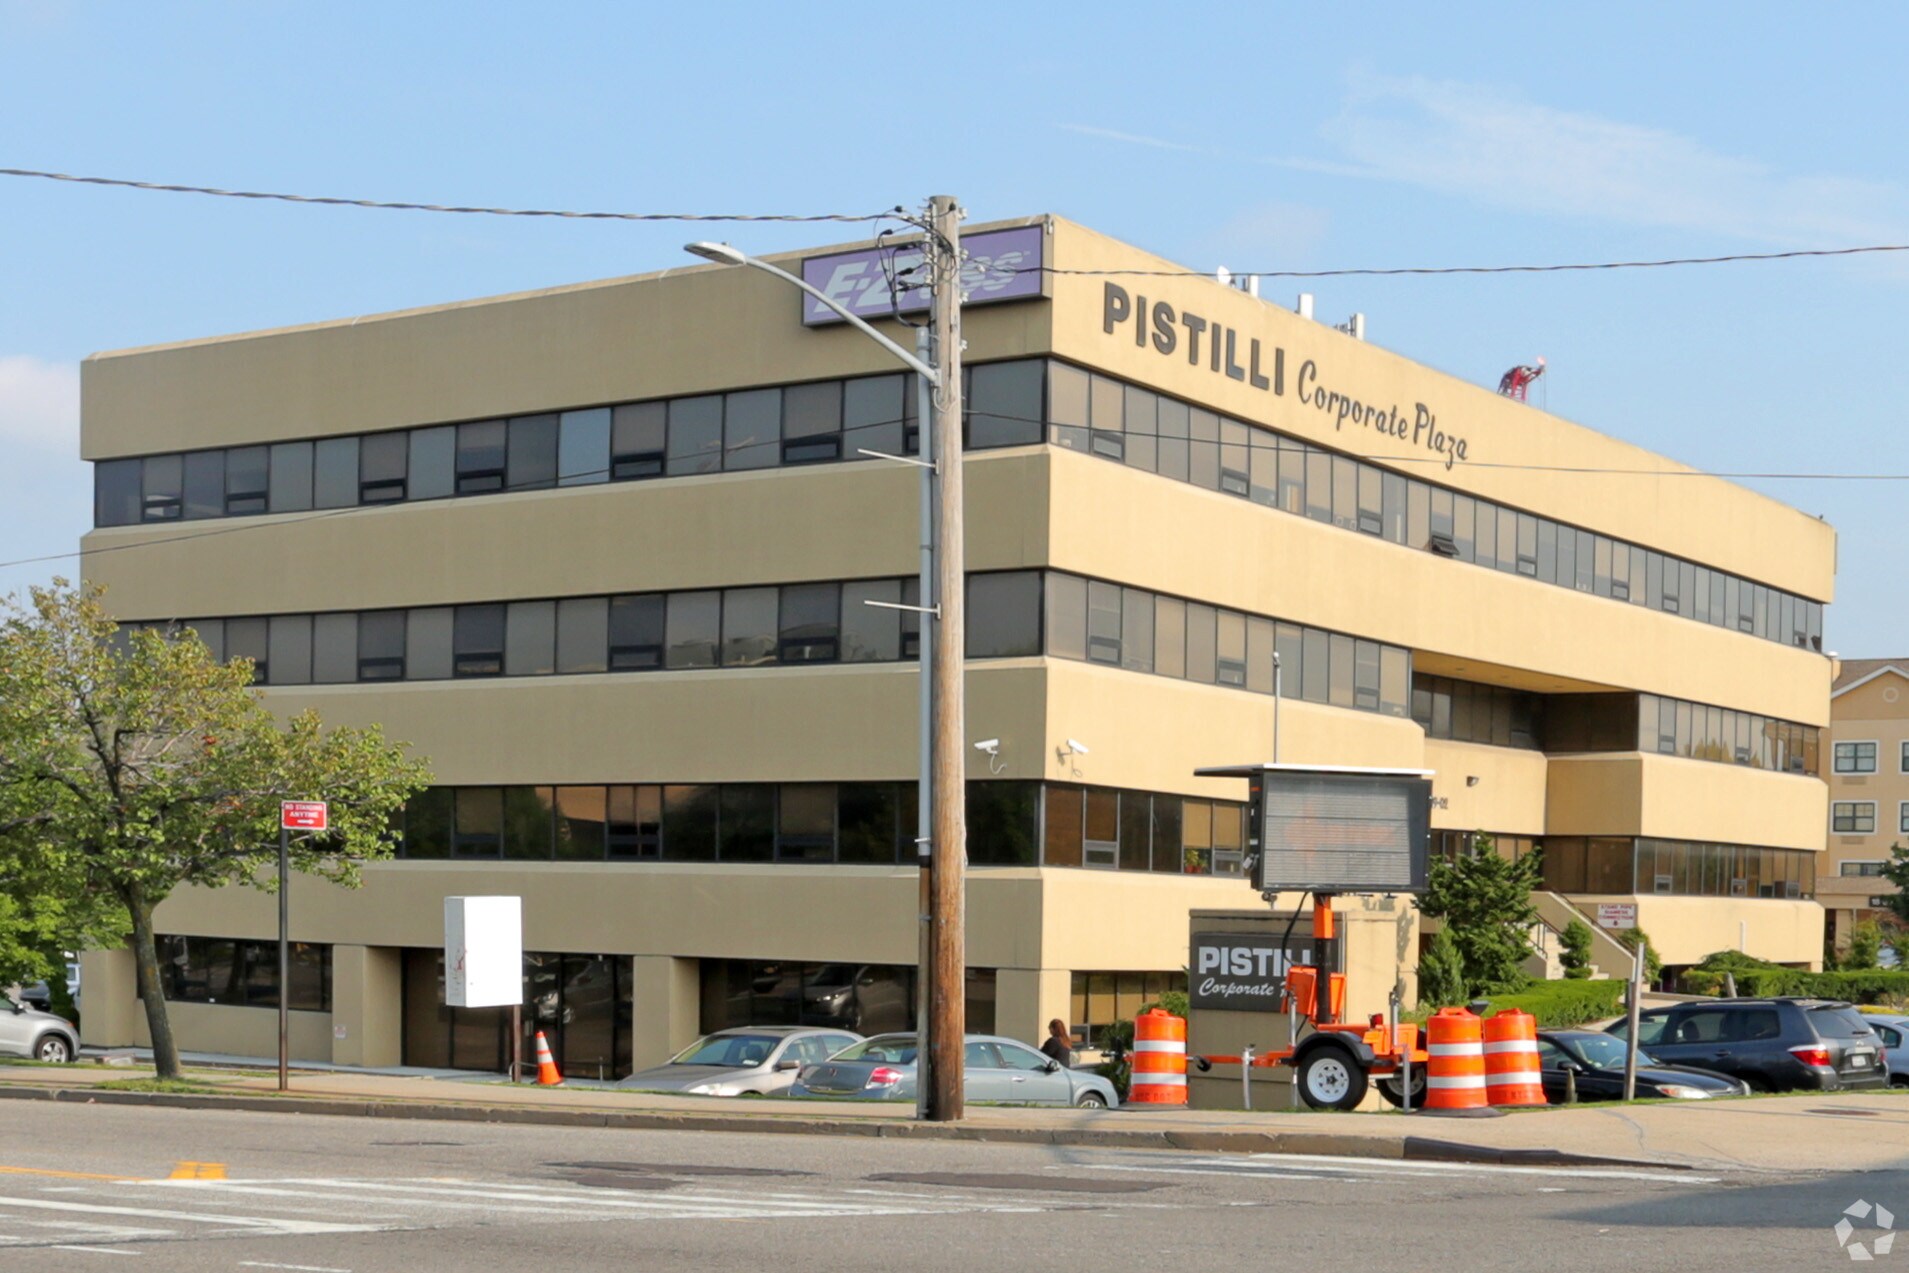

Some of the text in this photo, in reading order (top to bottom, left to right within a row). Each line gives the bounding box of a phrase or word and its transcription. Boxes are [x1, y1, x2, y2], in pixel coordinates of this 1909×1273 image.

[1103, 281, 1468, 471] PISTILLI Corporate Plaza
[1199, 977, 1274, 998] Corporate
